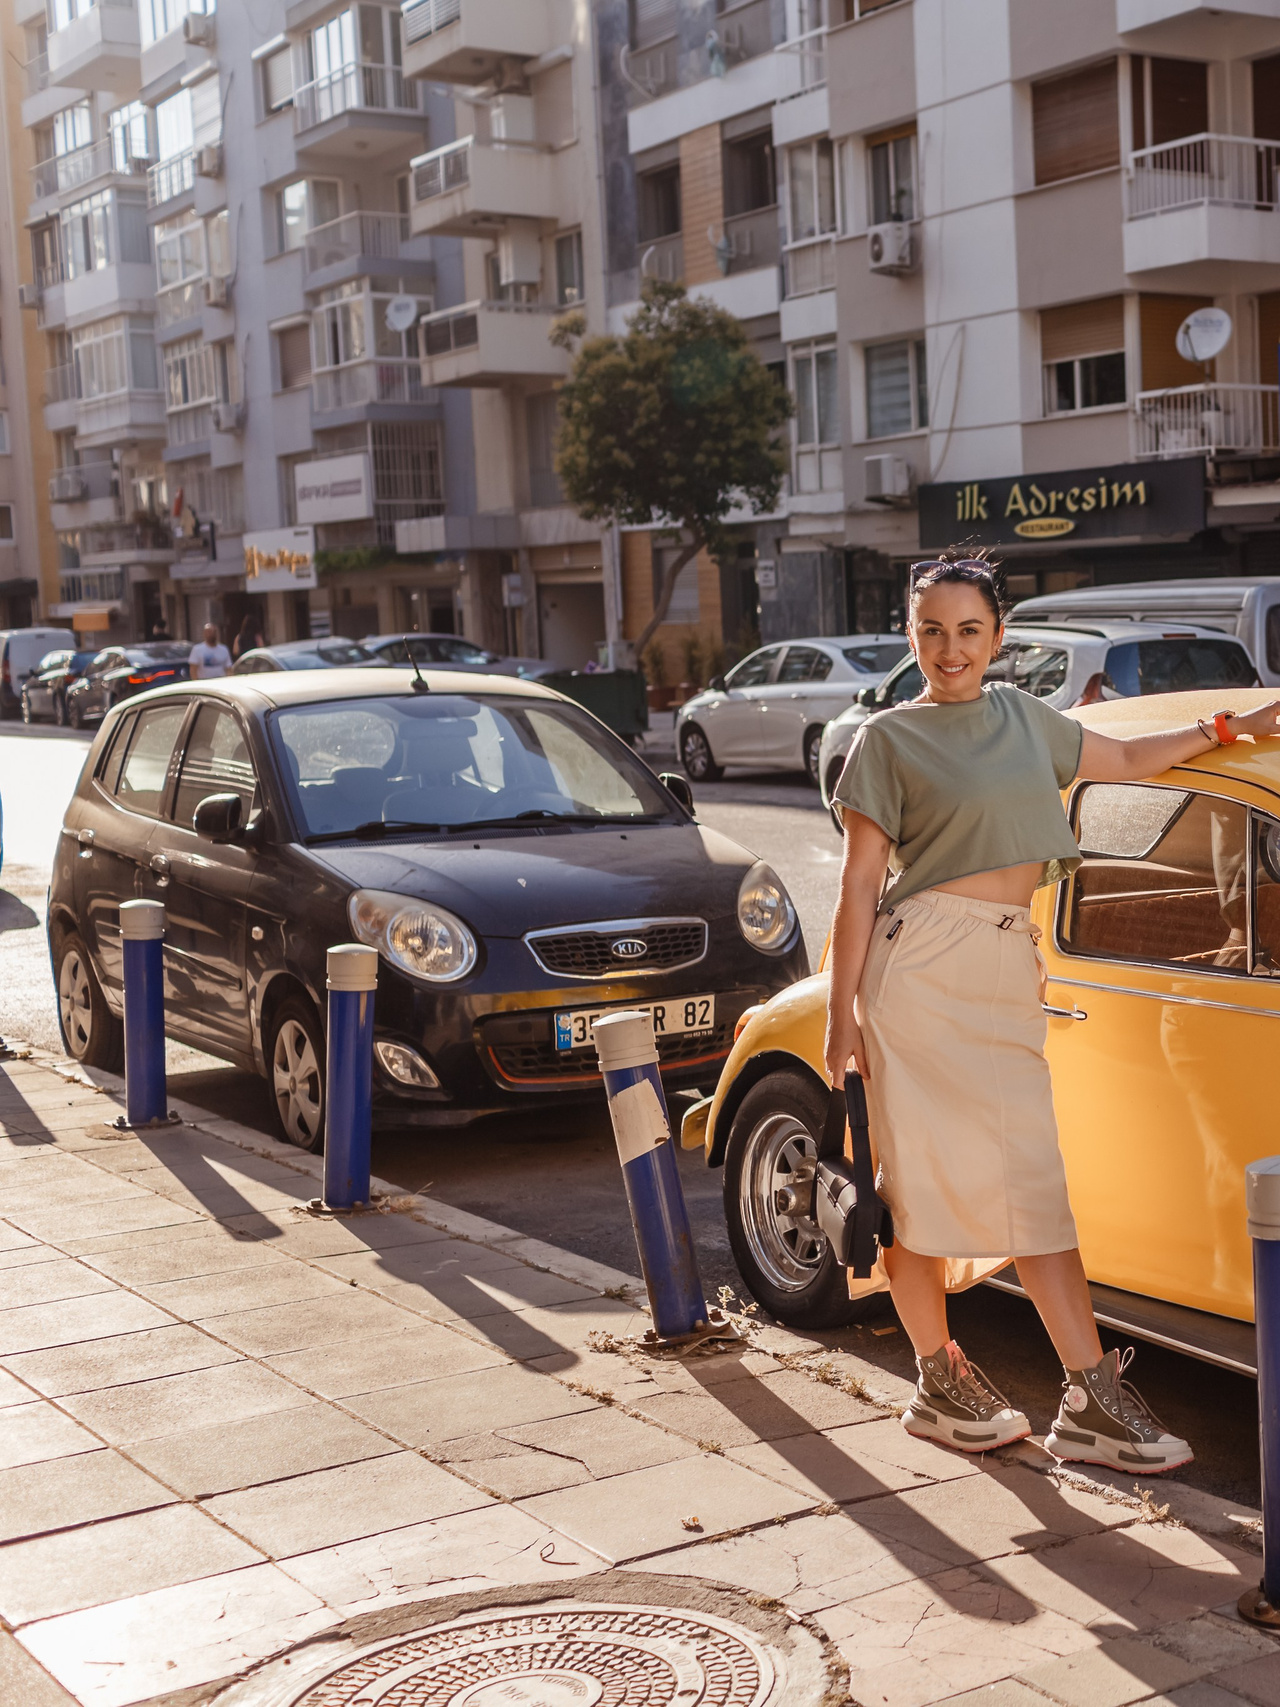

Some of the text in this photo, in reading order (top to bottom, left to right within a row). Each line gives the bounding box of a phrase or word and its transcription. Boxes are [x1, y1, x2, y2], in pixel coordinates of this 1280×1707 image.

[956, 477, 1147, 521] ilk Adresim
[1020, 521, 1071, 534] RESTAURANT
[617, 942, 642, 954] KIA
[684, 1000, 710, 1028] 82
[560, 1033, 570, 1042] TR
